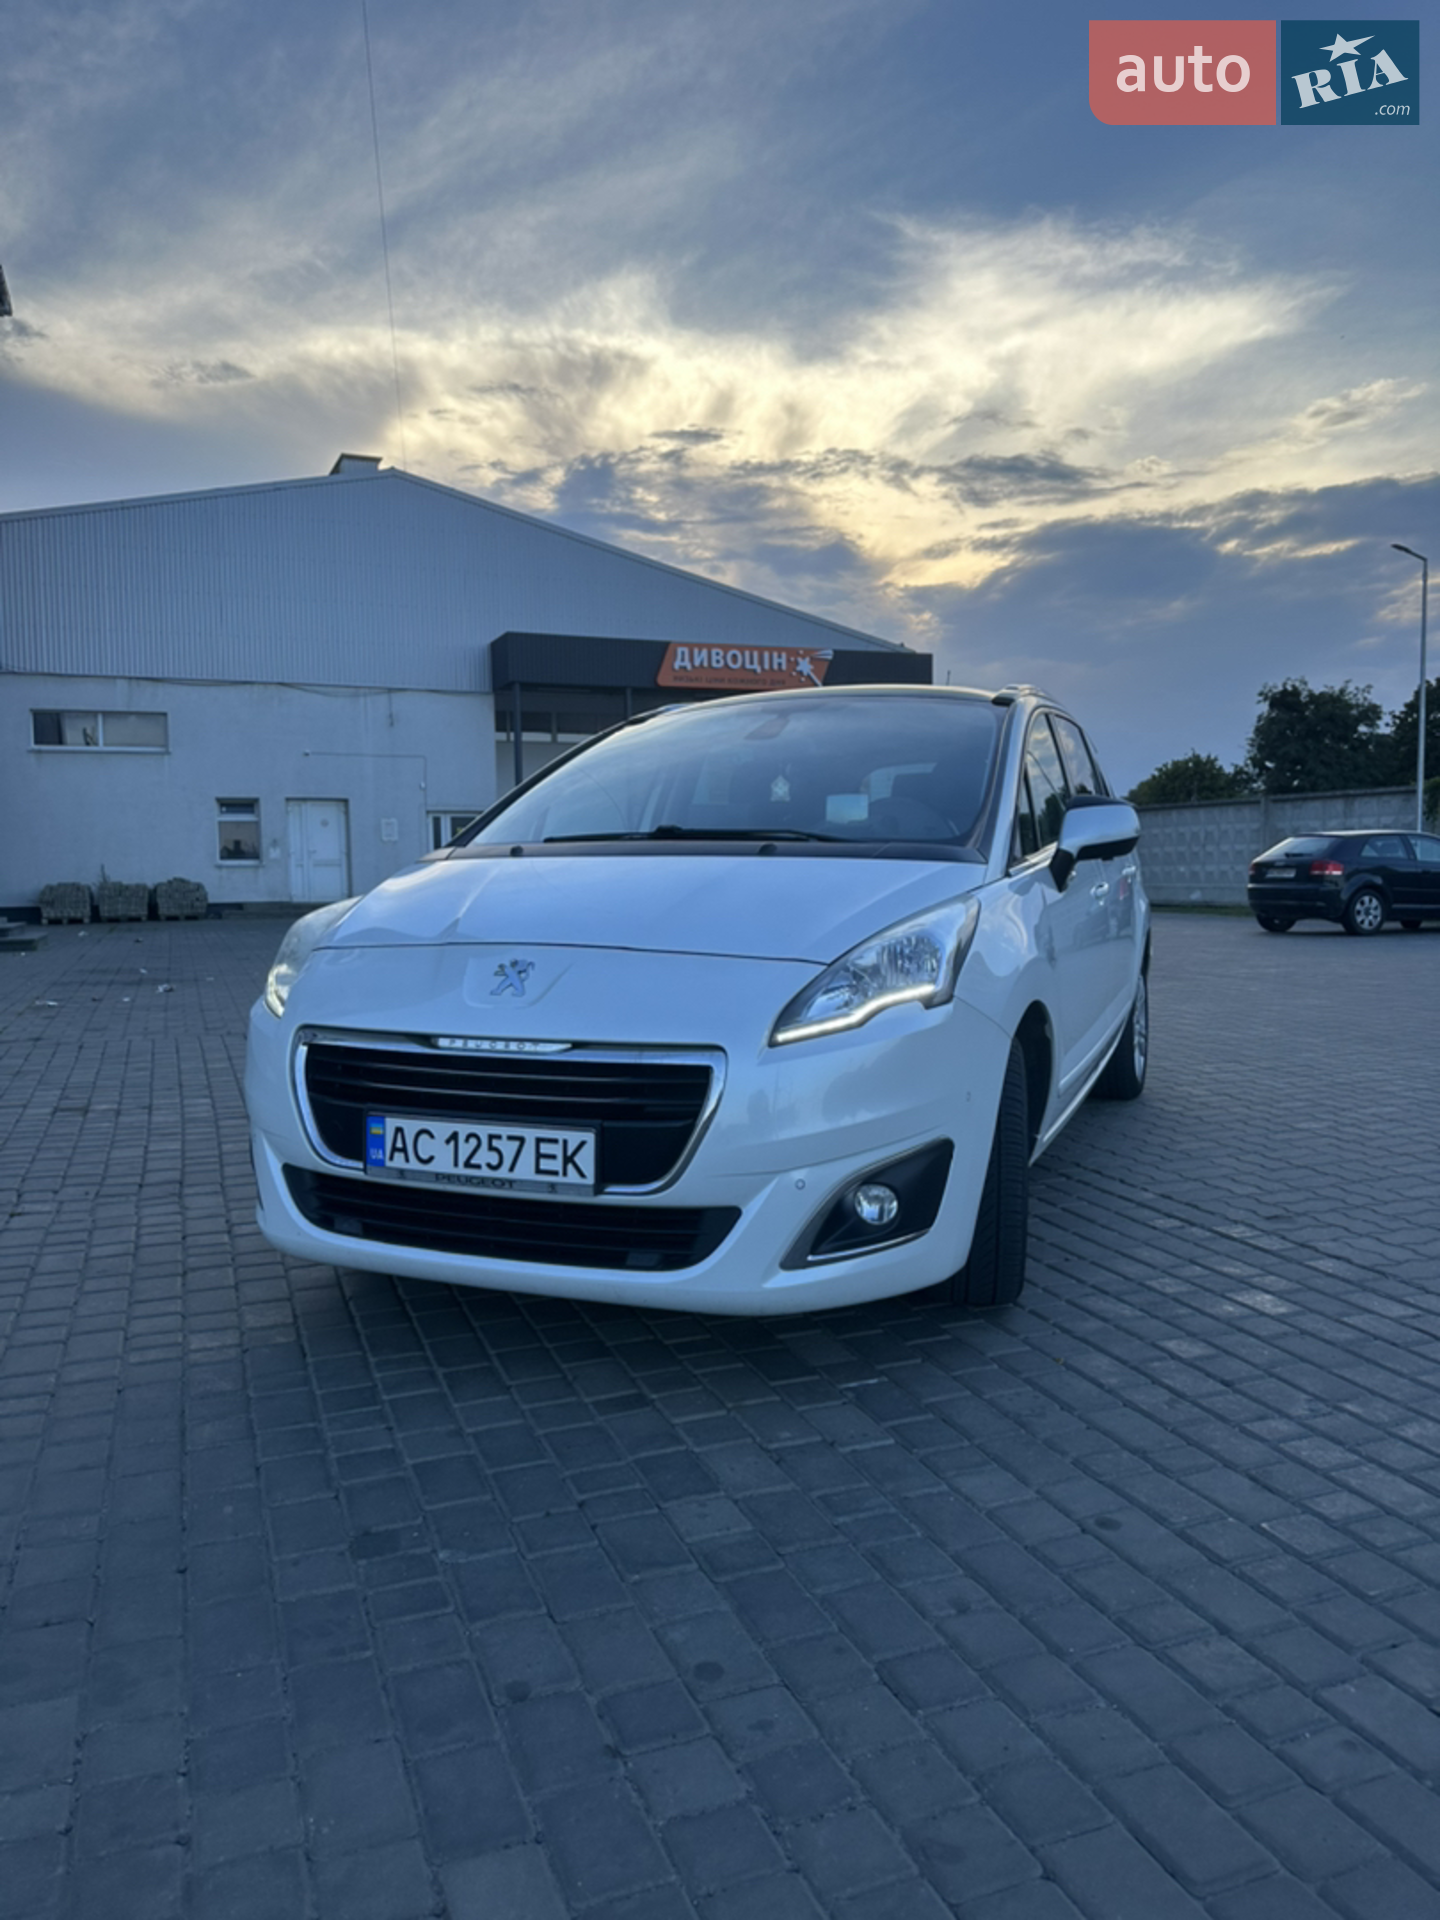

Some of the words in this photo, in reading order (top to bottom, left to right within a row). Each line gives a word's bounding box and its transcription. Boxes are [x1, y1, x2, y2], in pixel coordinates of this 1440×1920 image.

[673, 646, 787, 674] ДИВОЦІН
[388, 1126, 436, 1165] AC
[444, 1130, 527, 1173] 1257
[534, 1137, 588, 1179] EK
[435, 1172, 518, 1189] PEUGEOT
